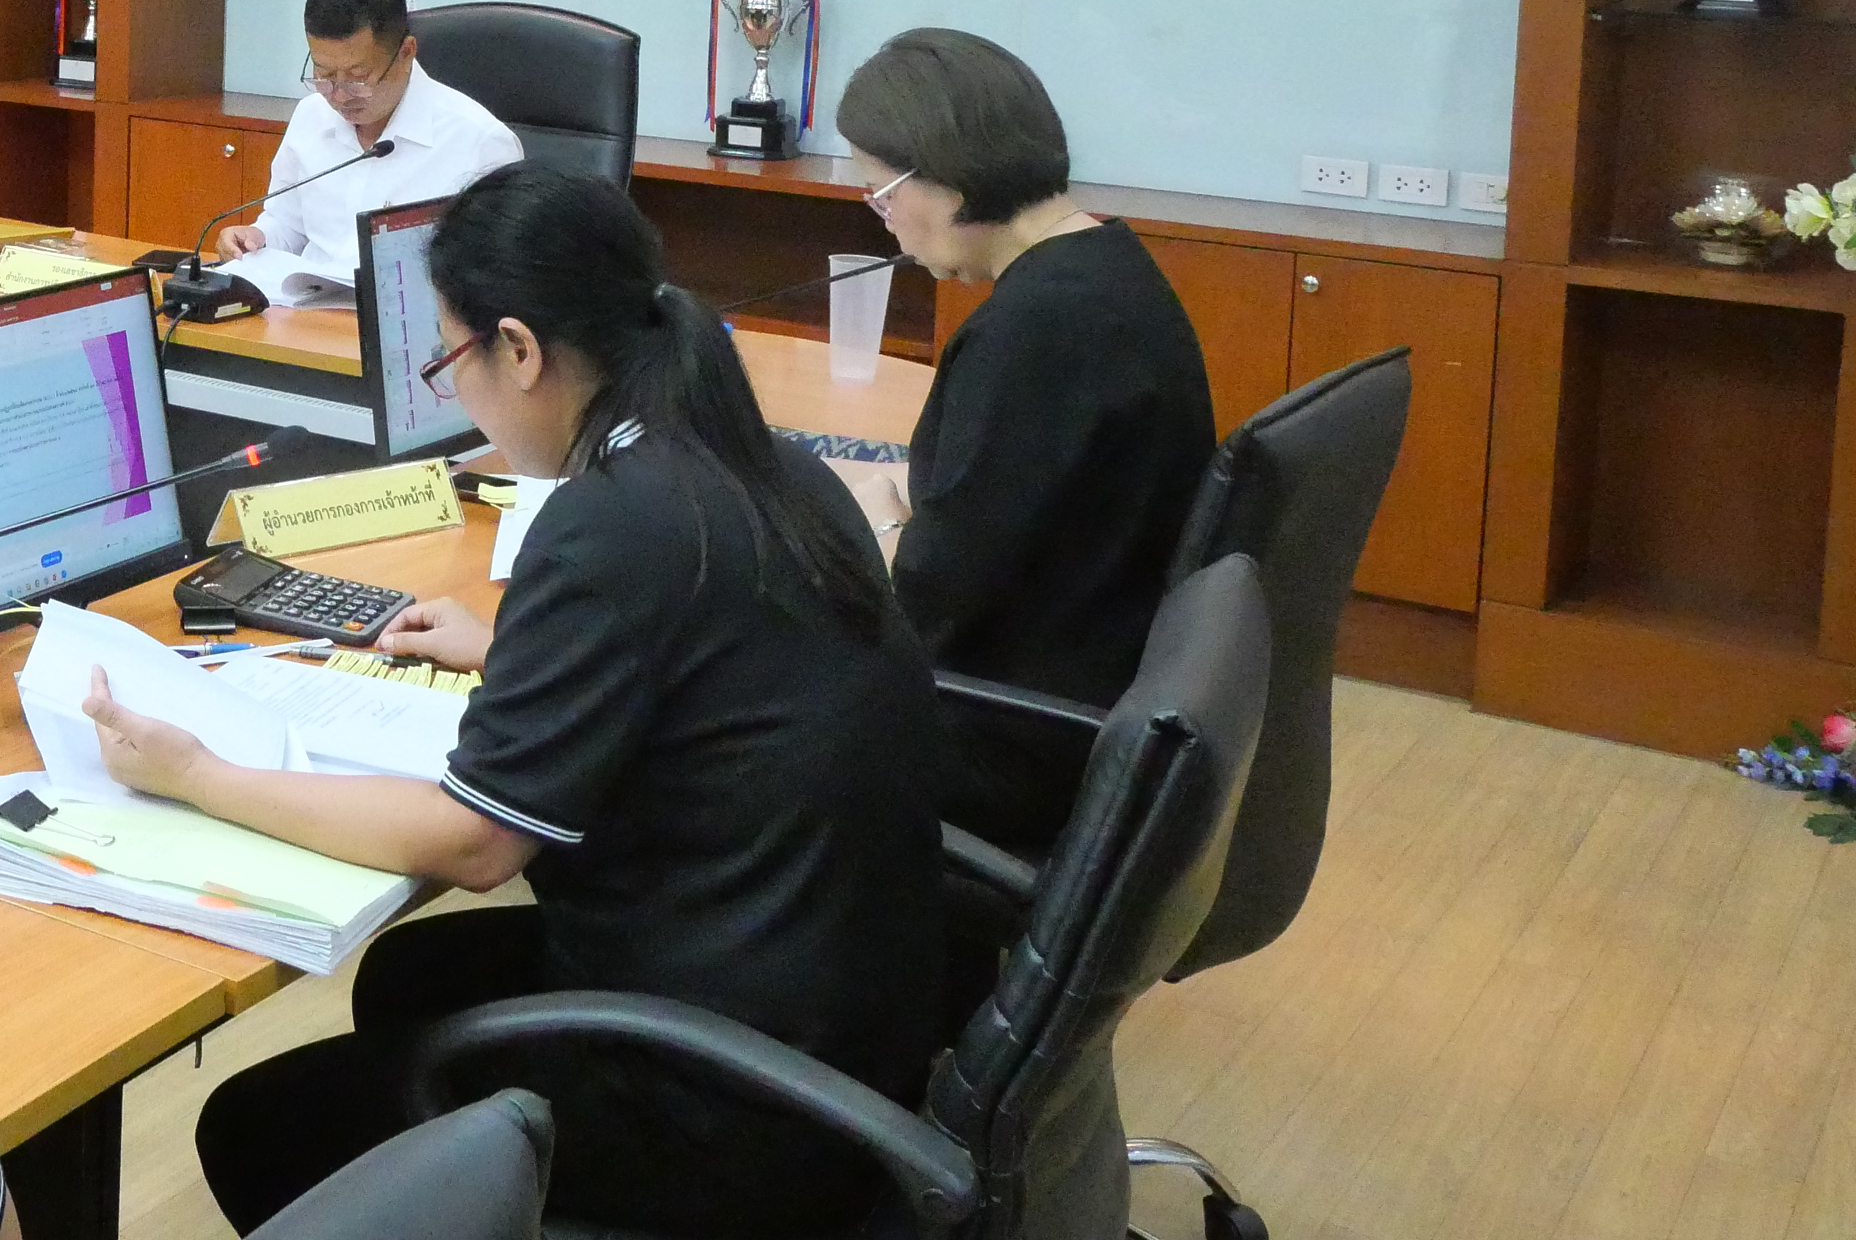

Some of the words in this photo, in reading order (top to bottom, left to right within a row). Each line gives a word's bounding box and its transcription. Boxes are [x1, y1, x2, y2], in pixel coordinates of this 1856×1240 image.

[262, 479, 437, 537] ผู้อำนวยการกองการเจ้าหน้าที่
